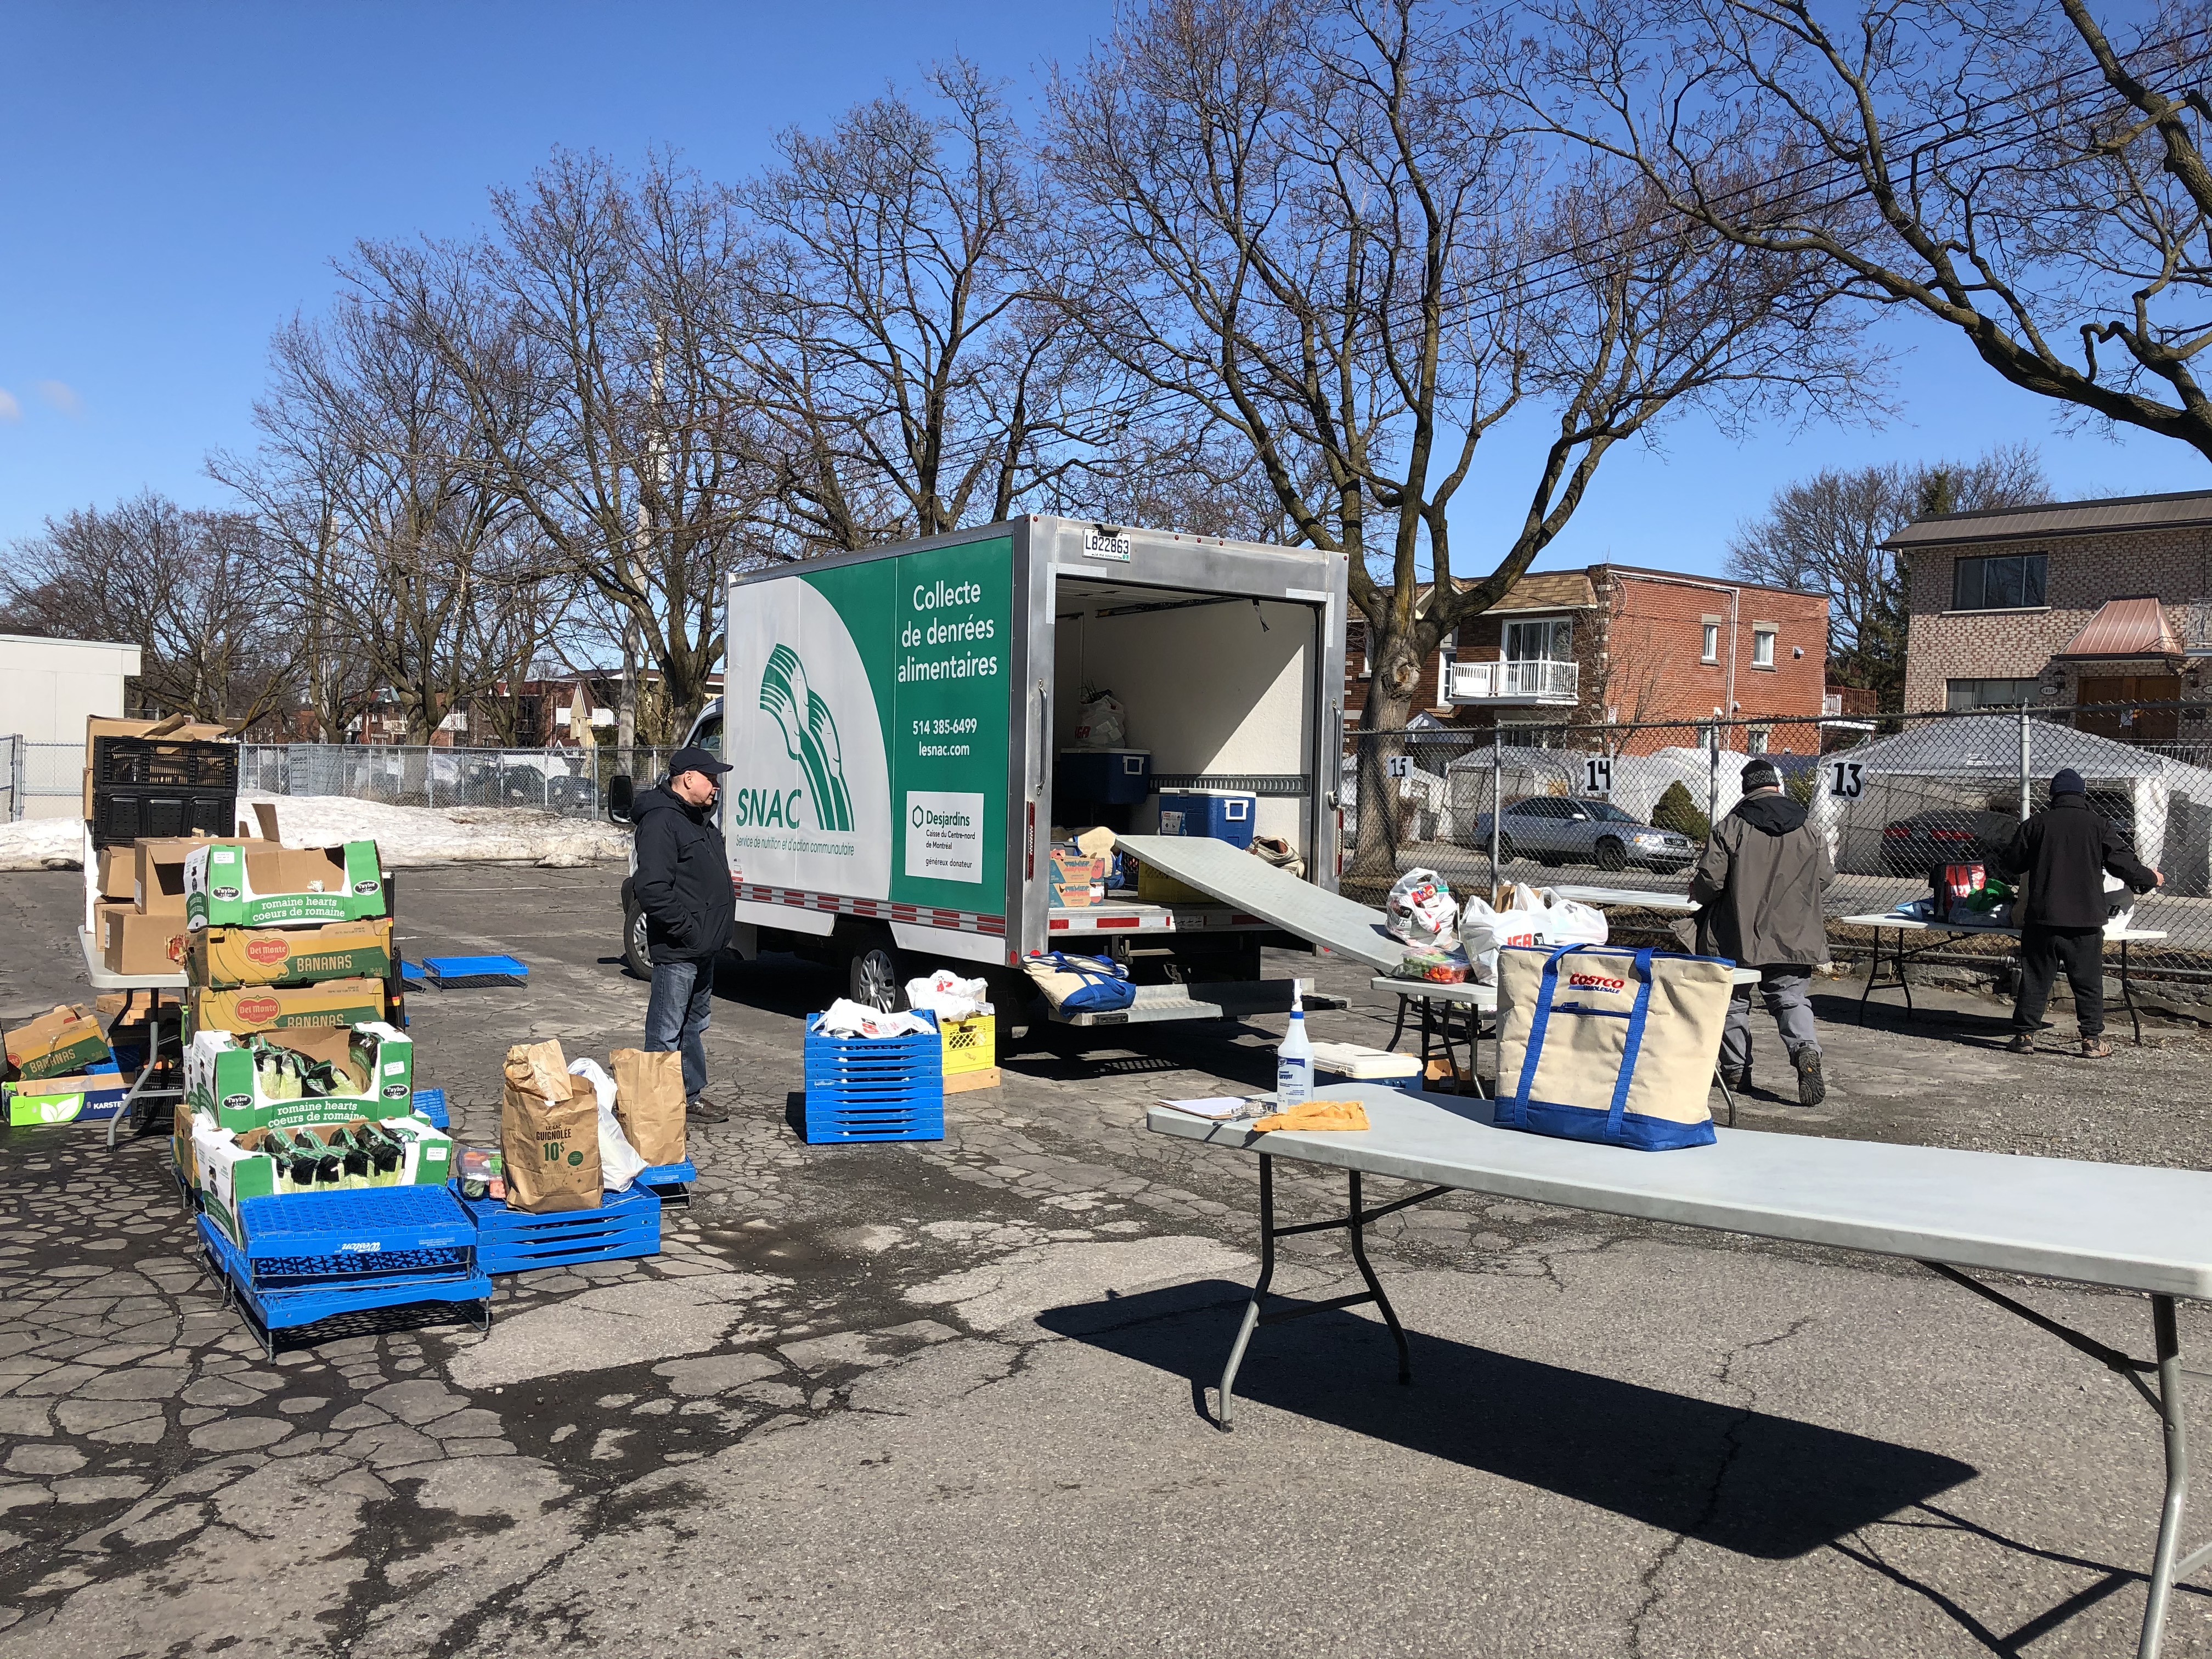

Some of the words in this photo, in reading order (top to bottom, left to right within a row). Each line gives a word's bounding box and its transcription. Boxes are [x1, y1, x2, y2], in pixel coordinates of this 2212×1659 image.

[1086, 534, 1128, 554] L822863
[913, 580, 980, 611] Collecte
[902, 620, 921, 647] de
[927, 614, 994, 645] denrées
[898, 651, 997, 682] alimentaires
[913, 720, 930, 735] 514
[933, 718, 977, 734] 385-6499
[919, 741, 969, 756] lesnac.com
[1391, 758, 1406, 777] 15
[1587, 760, 1611, 791] 14
[1831, 763, 1863, 797] 13
[736, 788, 802, 830] SNAC
[926, 810, 970, 828] Desjardins
[947, 831, 975, 839] Centre-nord
[736, 834, 753, 848] Service
[754, 836, 760, 848] de
[761, 837, 781, 850] nutrition
[782, 838, 787, 850] et
[788, 838, 809, 852] d'action
[810, 842, 854, 856] communautaire
[933, 841, 952, 849] Montréal
[926, 857, 948, 866] généreux
[950, 859, 972, 868] donateur
[261, 898, 303, 910] romaine
[306, 896, 337, 907] hearts
[252, 910, 287, 922] coeurs
[289, 907, 302, 917] de
[304, 906, 345, 918] romaine
[297, 955, 352, 973] BANANAS
[1570, 973, 1625, 989] COSTCO
[1583, 985, 1620, 994] WHOLESALE
[239, 1006, 251, 1014] Del
[252, 1005, 276, 1013] Monte
[287, 1014, 344, 1028] BANANAS
[29, 1048, 76, 1073] BANANAS
[386, 1085, 405, 1094] Taylor
[94, 1101, 123, 1109] KARSTE
[226, 1096, 249, 1104] Taylor
[277, 1103, 323, 1115] romaine
[324, 1101, 358, 1111] hearts
[268, 1115, 304, 1128] coeurs
[306, 1111, 320, 1121] de
[323, 1110, 365, 1121] romaine
[536, 1127, 571, 1141] GUIGNOLÉE
[341, 1242, 381, 1252] Weston
